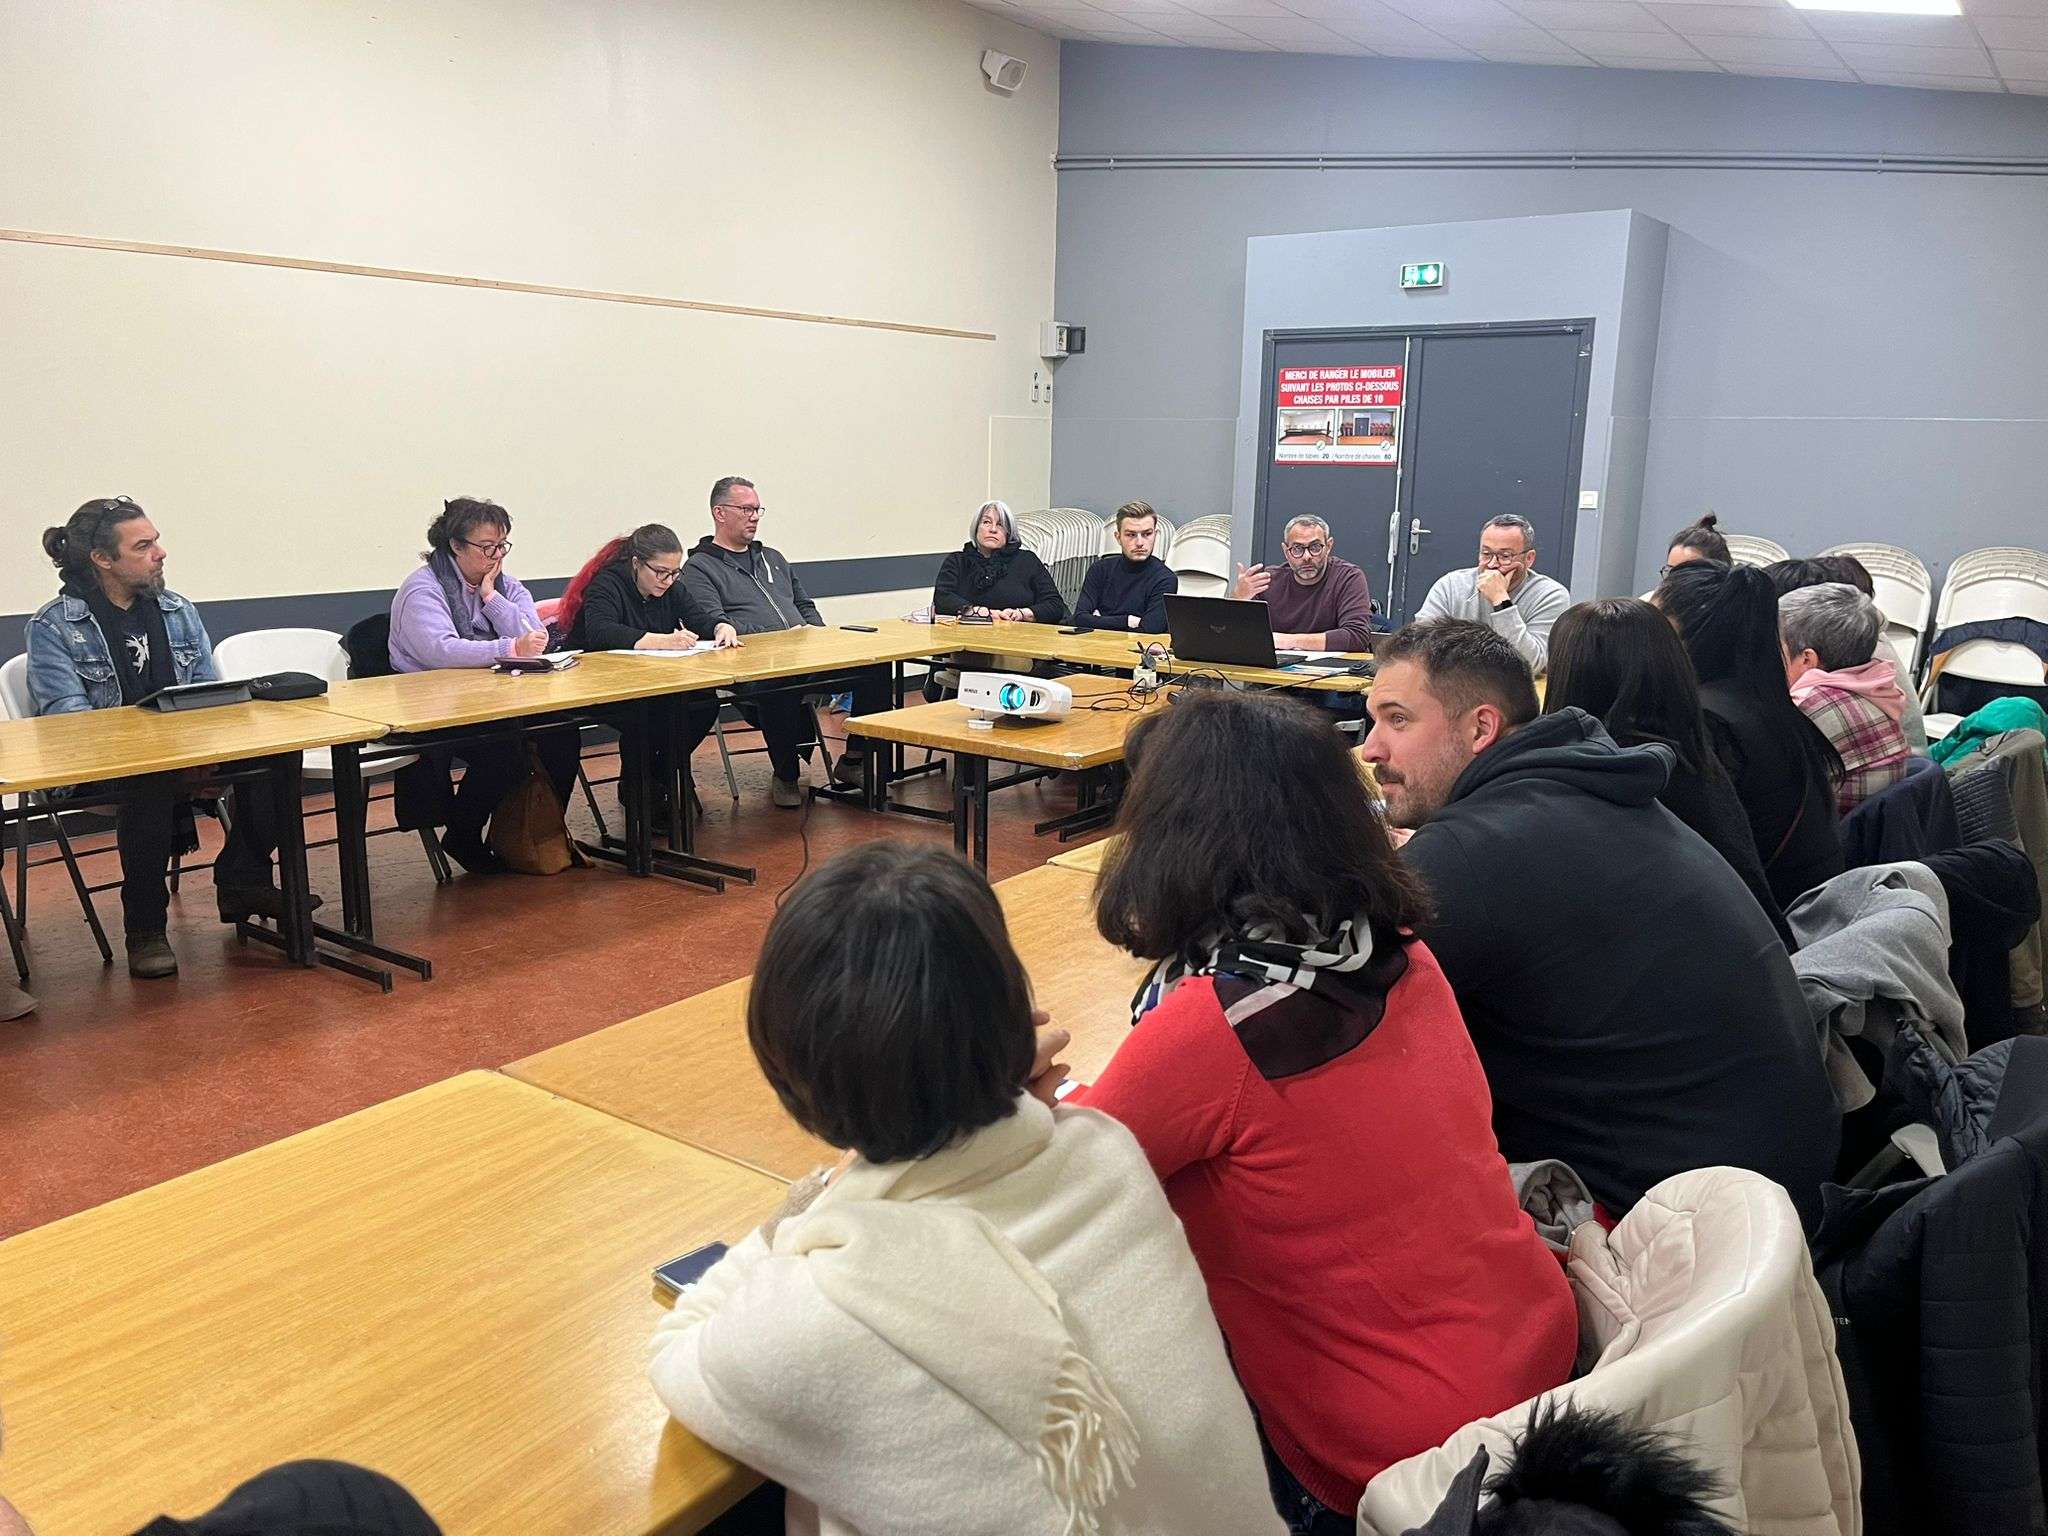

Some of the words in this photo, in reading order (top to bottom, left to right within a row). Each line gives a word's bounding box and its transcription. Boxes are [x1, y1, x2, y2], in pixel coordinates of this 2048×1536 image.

[1285, 370, 1307, 380] MERCI
[1309, 370, 1319, 379] DE
[1320, 369, 1348, 379] RANGER
[1350, 369, 1360, 379] LE
[1360, 368, 1396, 379] MOBILIER
[1281, 382, 1310, 392] SUIVANT
[1311, 382, 1324, 392] LES
[1326, 381, 1354, 392] PHOTOS
[1355, 380, 1399, 391] CI-DESSOUS
[1293, 395, 1323, 405] CHAISES
[1325, 395, 1339, 404] PAR
[1340, 394, 1361, 404] PILES
[1362, 394, 1373, 404] DE
[1374, 394, 1384, 404] 10
